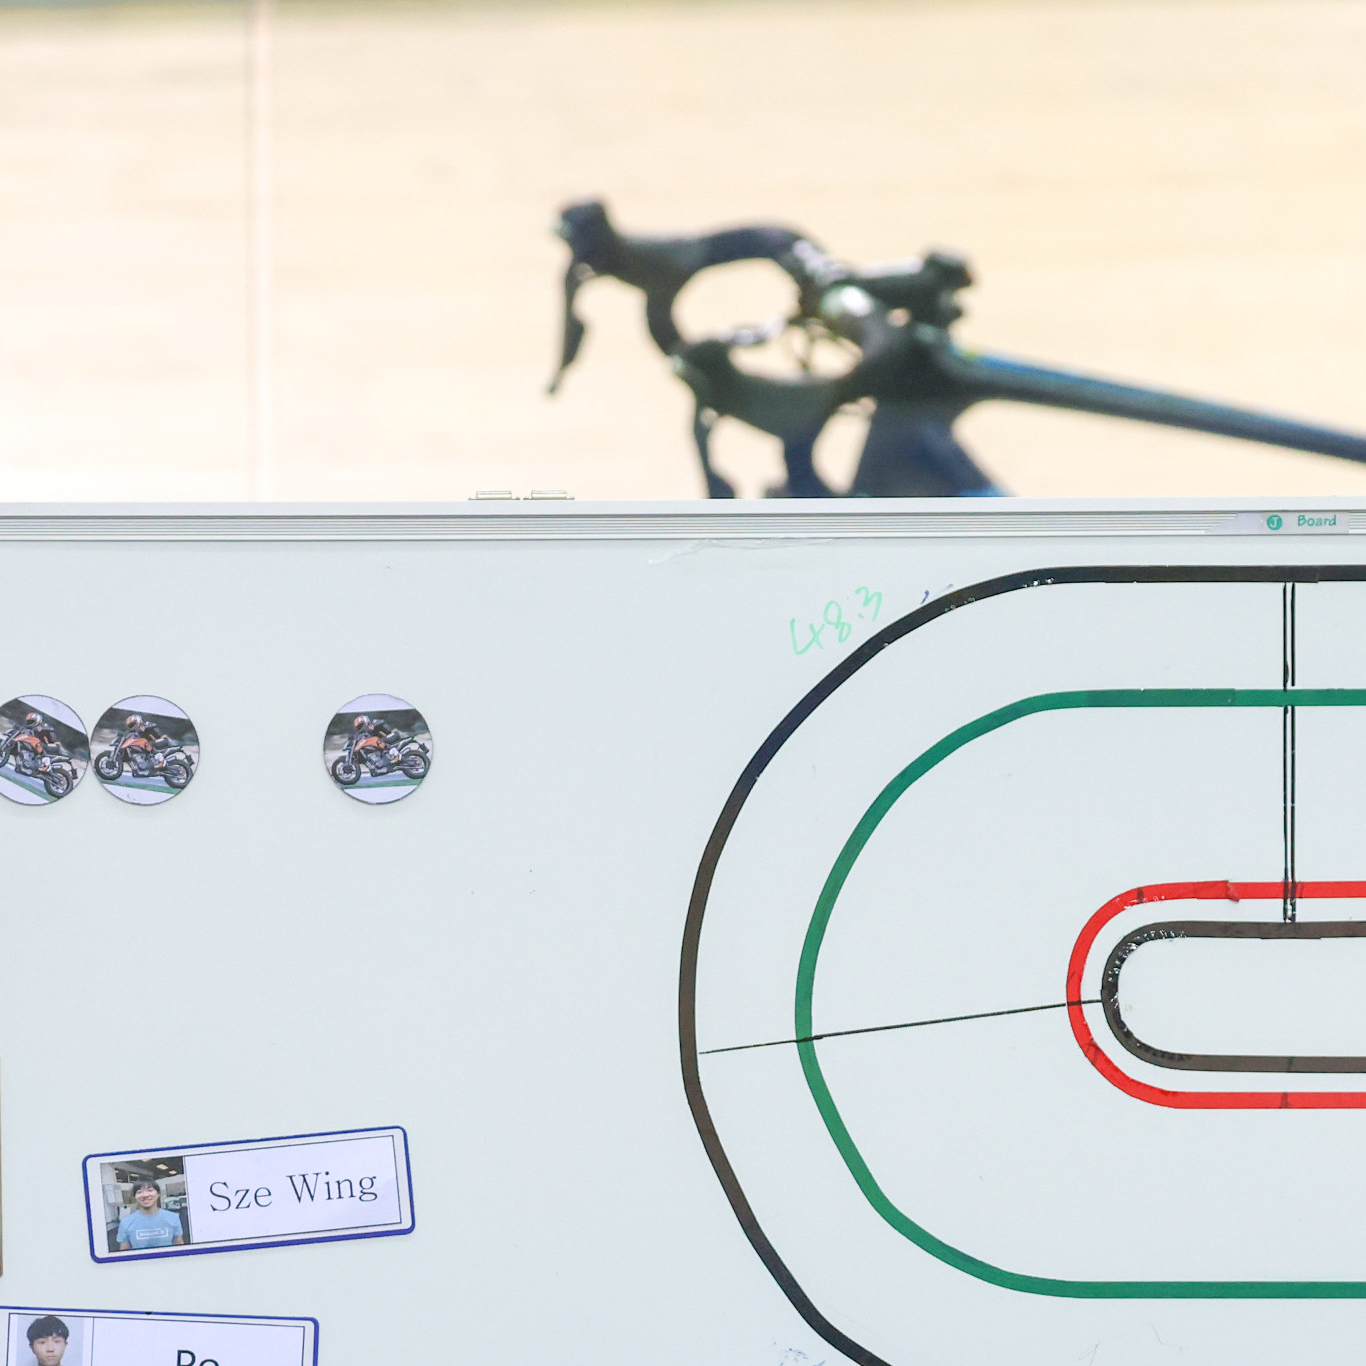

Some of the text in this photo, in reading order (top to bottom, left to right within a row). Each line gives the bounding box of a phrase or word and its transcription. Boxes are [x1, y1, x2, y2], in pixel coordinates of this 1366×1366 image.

[1297, 514, 1338, 527] Board
[209, 1172, 378, 1212] Sze Wing
